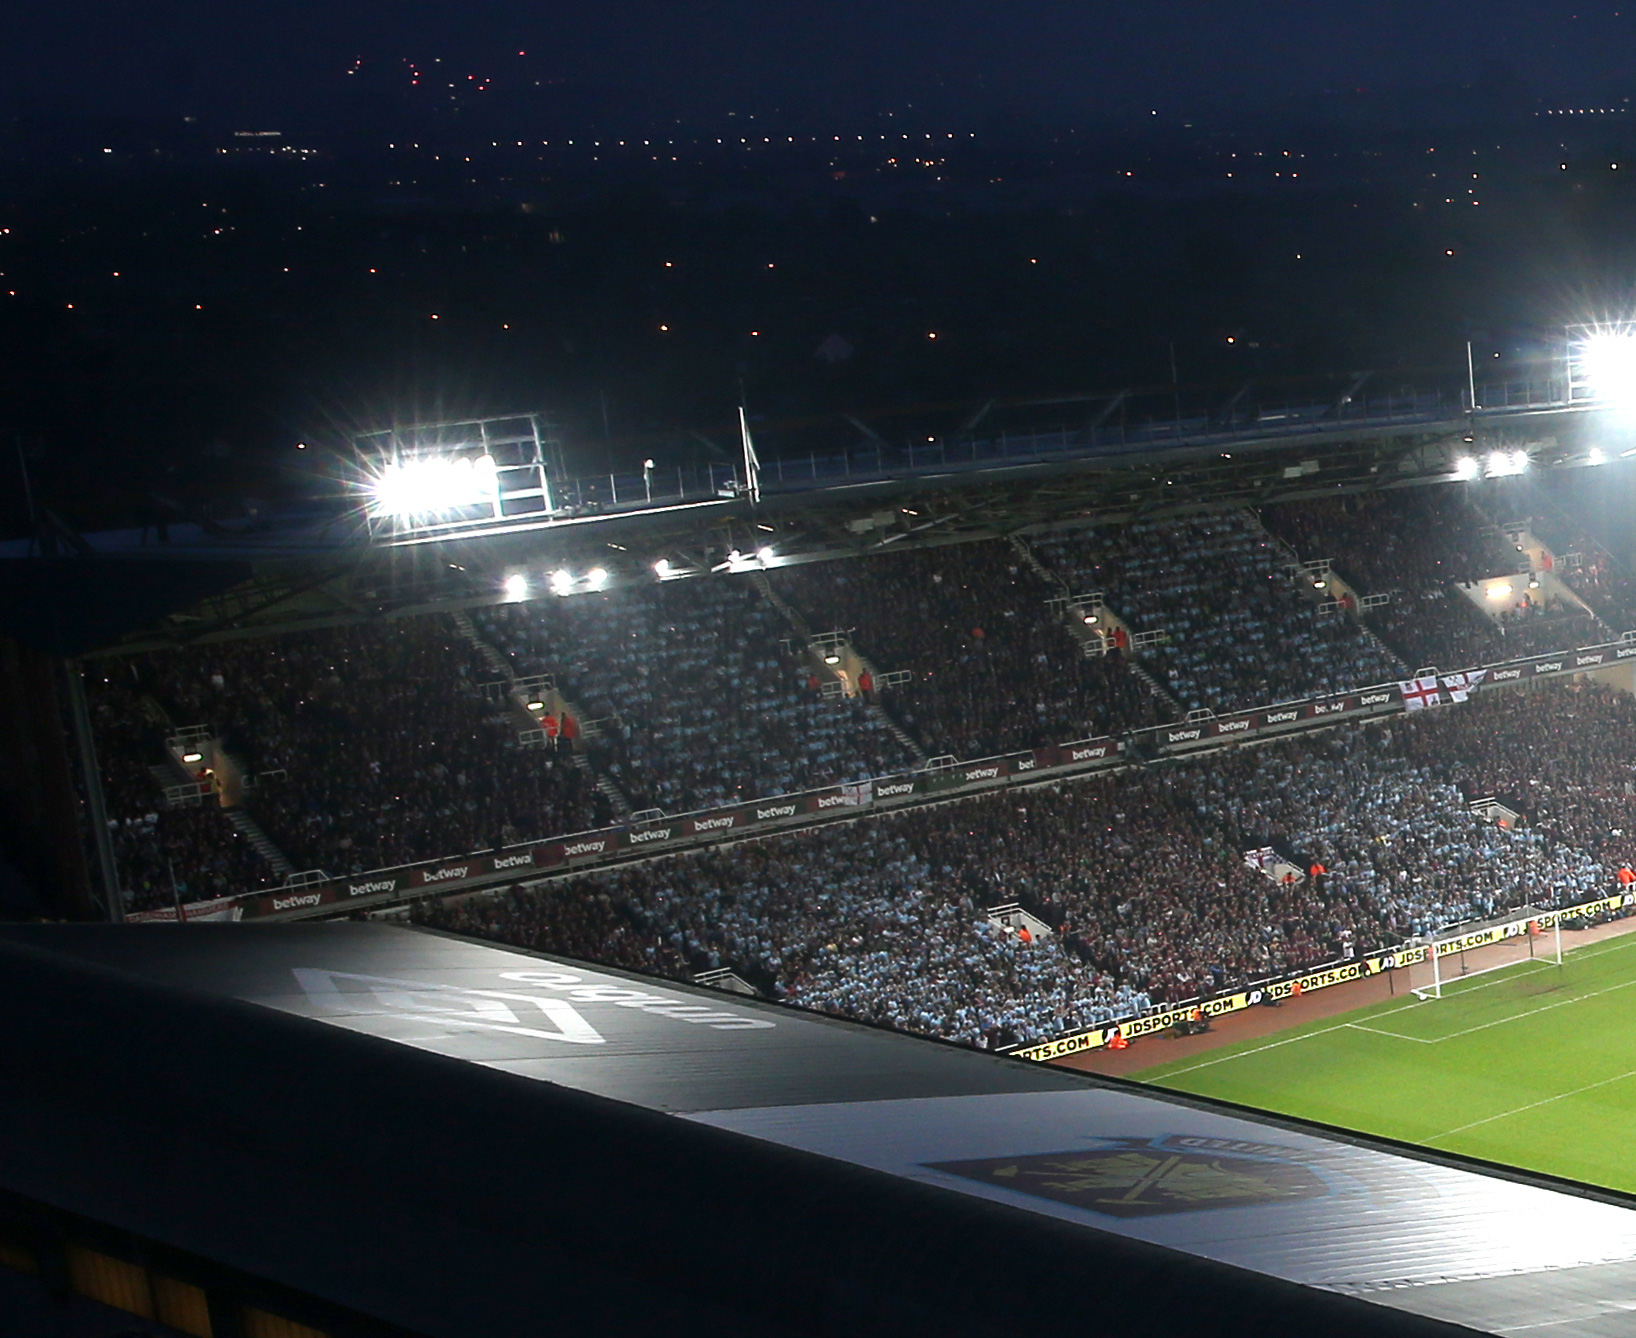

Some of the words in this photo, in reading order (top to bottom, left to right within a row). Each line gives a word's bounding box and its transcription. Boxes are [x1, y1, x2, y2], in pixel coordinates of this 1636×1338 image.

[1576, 654, 1603, 666] betway
[1493, 668, 1521, 680] betway
[1535, 661, 1563, 674] betway
[1361, 692, 1390, 705] betway
[1314, 701, 1344, 714] beay
[1267, 710, 1298, 724] betway
[1218, 719, 1250, 733] betway
[1168, 729, 1201, 743] betway
[1072, 747, 1107, 760] betway
[877, 781, 914, 797] betway
[757, 804, 796, 819] betway
[694, 816, 735, 831] betway
[629, 827, 672, 843] betway
[423, 864, 468, 882] betway
[349, 878, 396, 896] betway
[273, 892, 321, 910] betway
